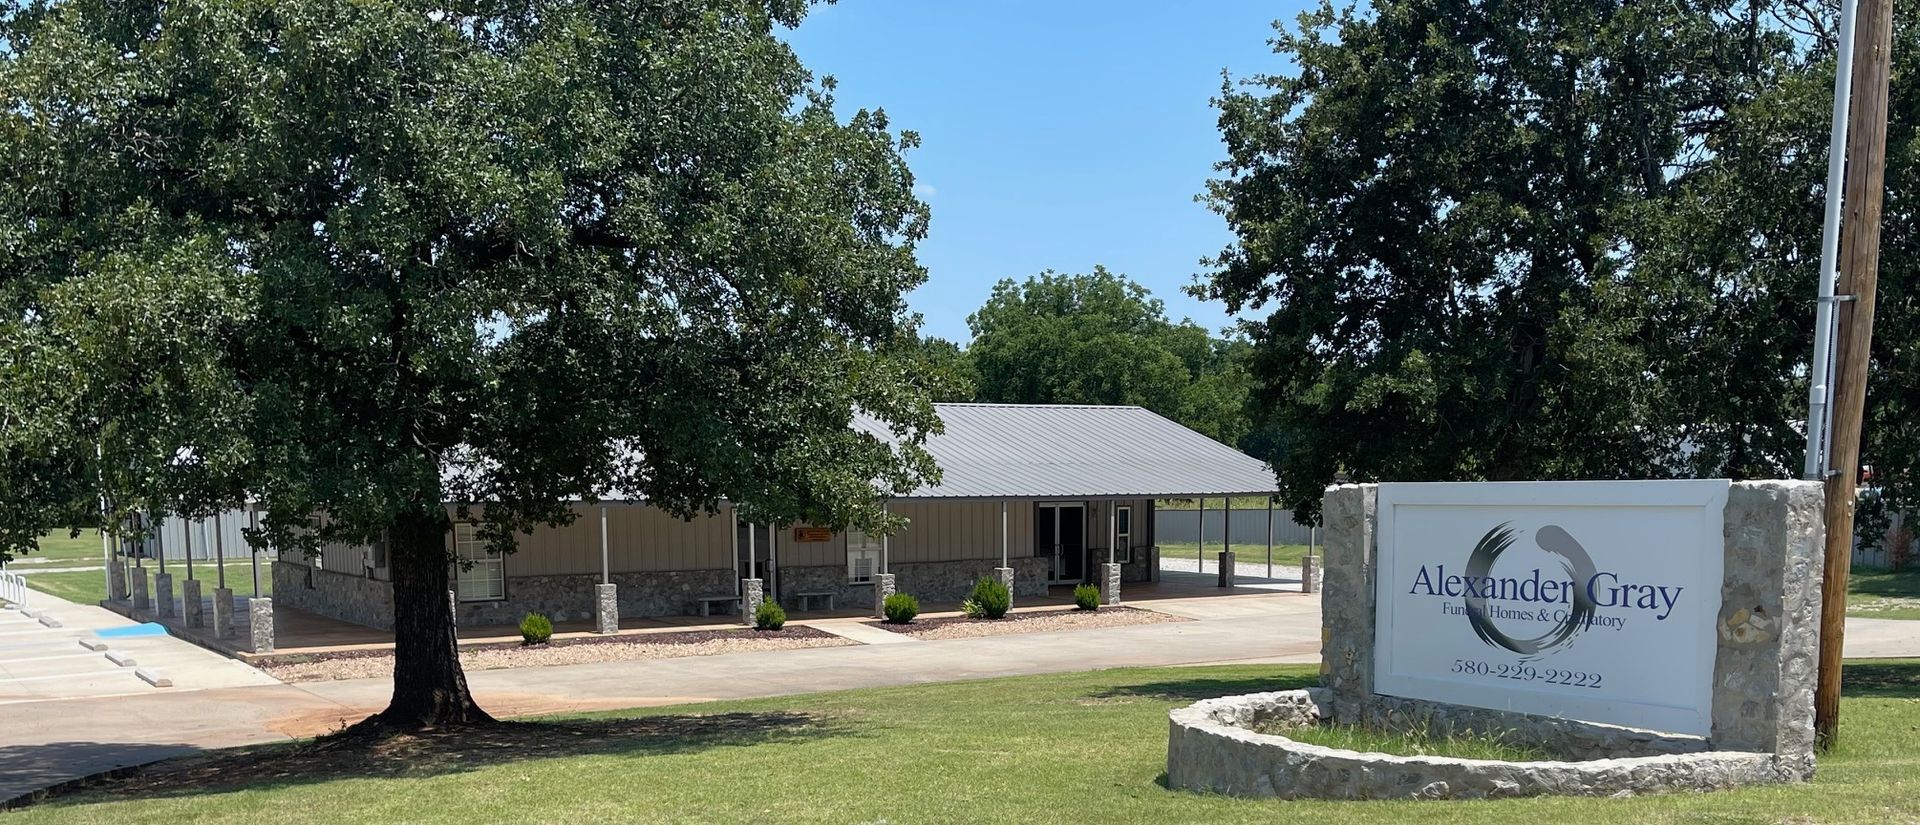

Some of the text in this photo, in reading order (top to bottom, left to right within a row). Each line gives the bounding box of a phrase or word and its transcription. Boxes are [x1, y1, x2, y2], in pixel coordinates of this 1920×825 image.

[1408, 564, 1684, 620] Alexander Gray
[1490, 605, 1534, 621] Homes
[1537, 608, 1550, 622] &
[1553, 609, 1626, 630] Cratory
[1450, 659, 1602, 689] 580-229-2222
